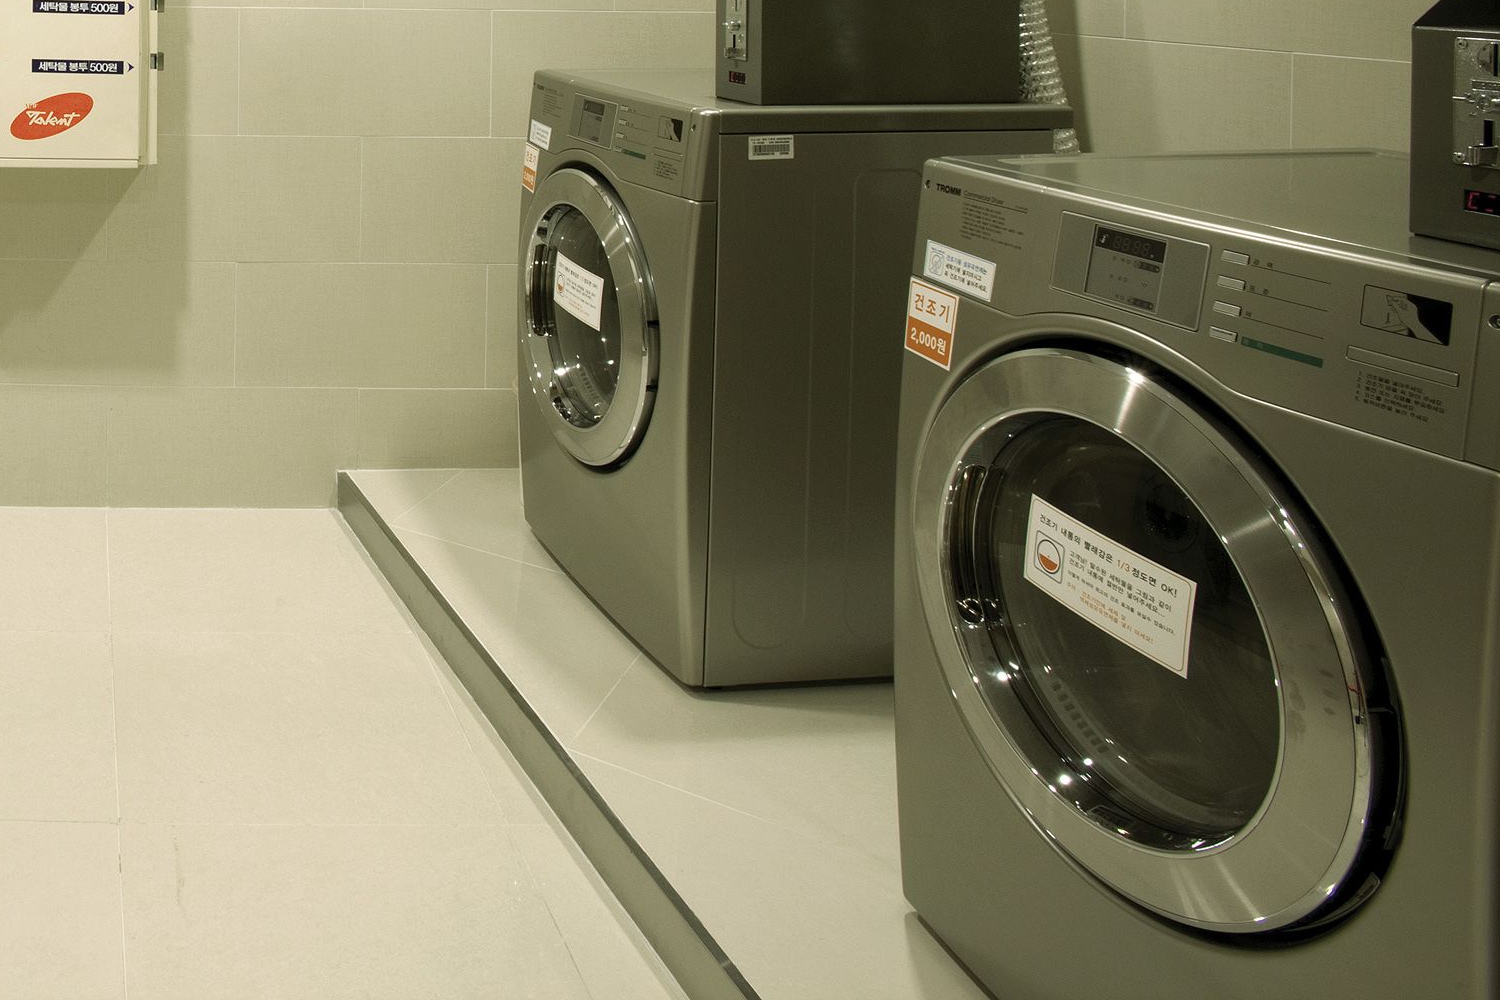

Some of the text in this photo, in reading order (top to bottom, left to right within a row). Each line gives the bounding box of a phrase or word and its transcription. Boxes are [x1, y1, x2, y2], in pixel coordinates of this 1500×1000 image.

[40, 2, 119, 13] 세탁물 봉투 500원
[39, 62, 117, 72] 세탁물 봉투 500원
[26, 111, 80, 126] Talent
[936, 183, 961, 196] TROMM
[915, 293, 950, 323] 건조기
[910, 327, 946, 356] 2,000원
[1039, 513, 1057, 531] 건조기
[1116, 558, 1130, 573] 1/3
[1131, 566, 1156, 588] 정도면
[1160, 581, 1177, 598] OK!
[1068, 557, 1084, 571] 건조기
